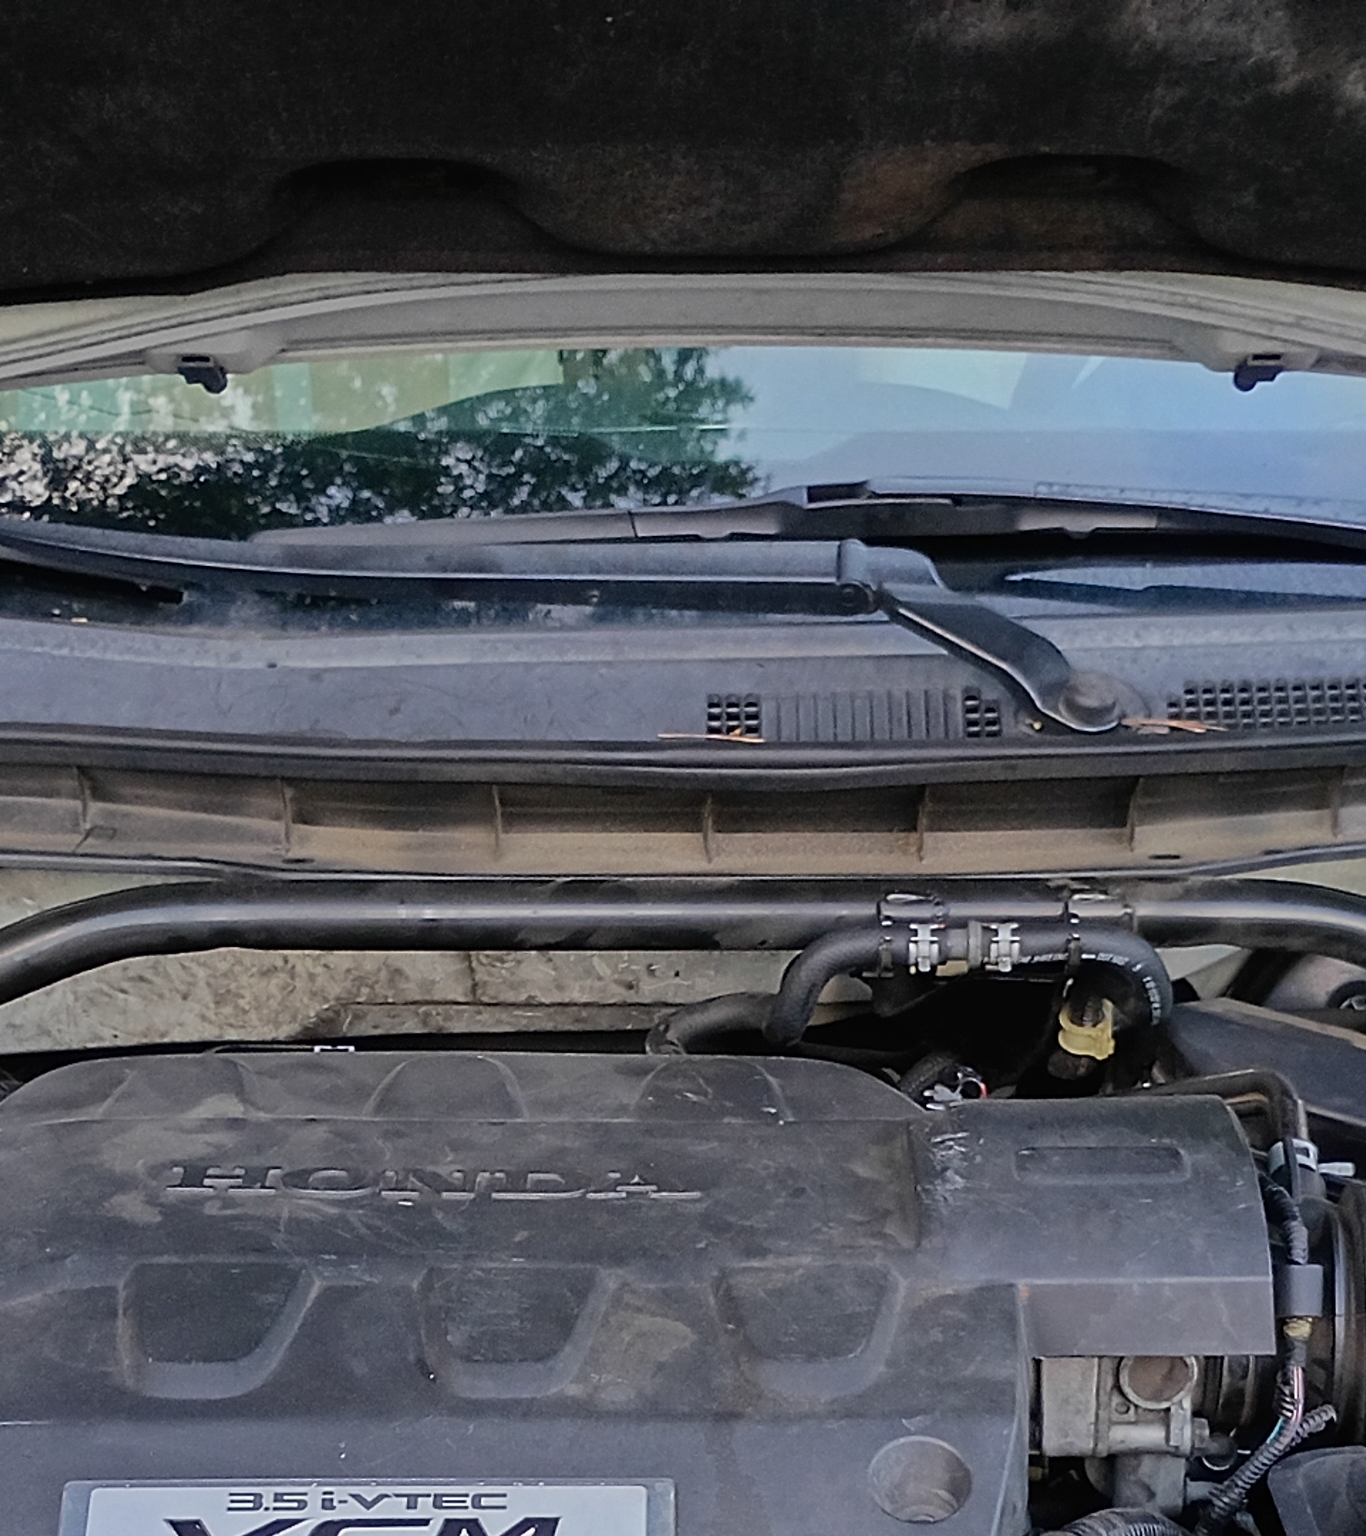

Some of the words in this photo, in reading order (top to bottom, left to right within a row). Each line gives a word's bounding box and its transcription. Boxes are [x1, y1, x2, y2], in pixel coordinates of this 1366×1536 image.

[165, 1164, 702, 1201] HONDA
[226, 1492, 308, 1512] 3.5
[320, 1489, 508, 1512] i-VTEC
